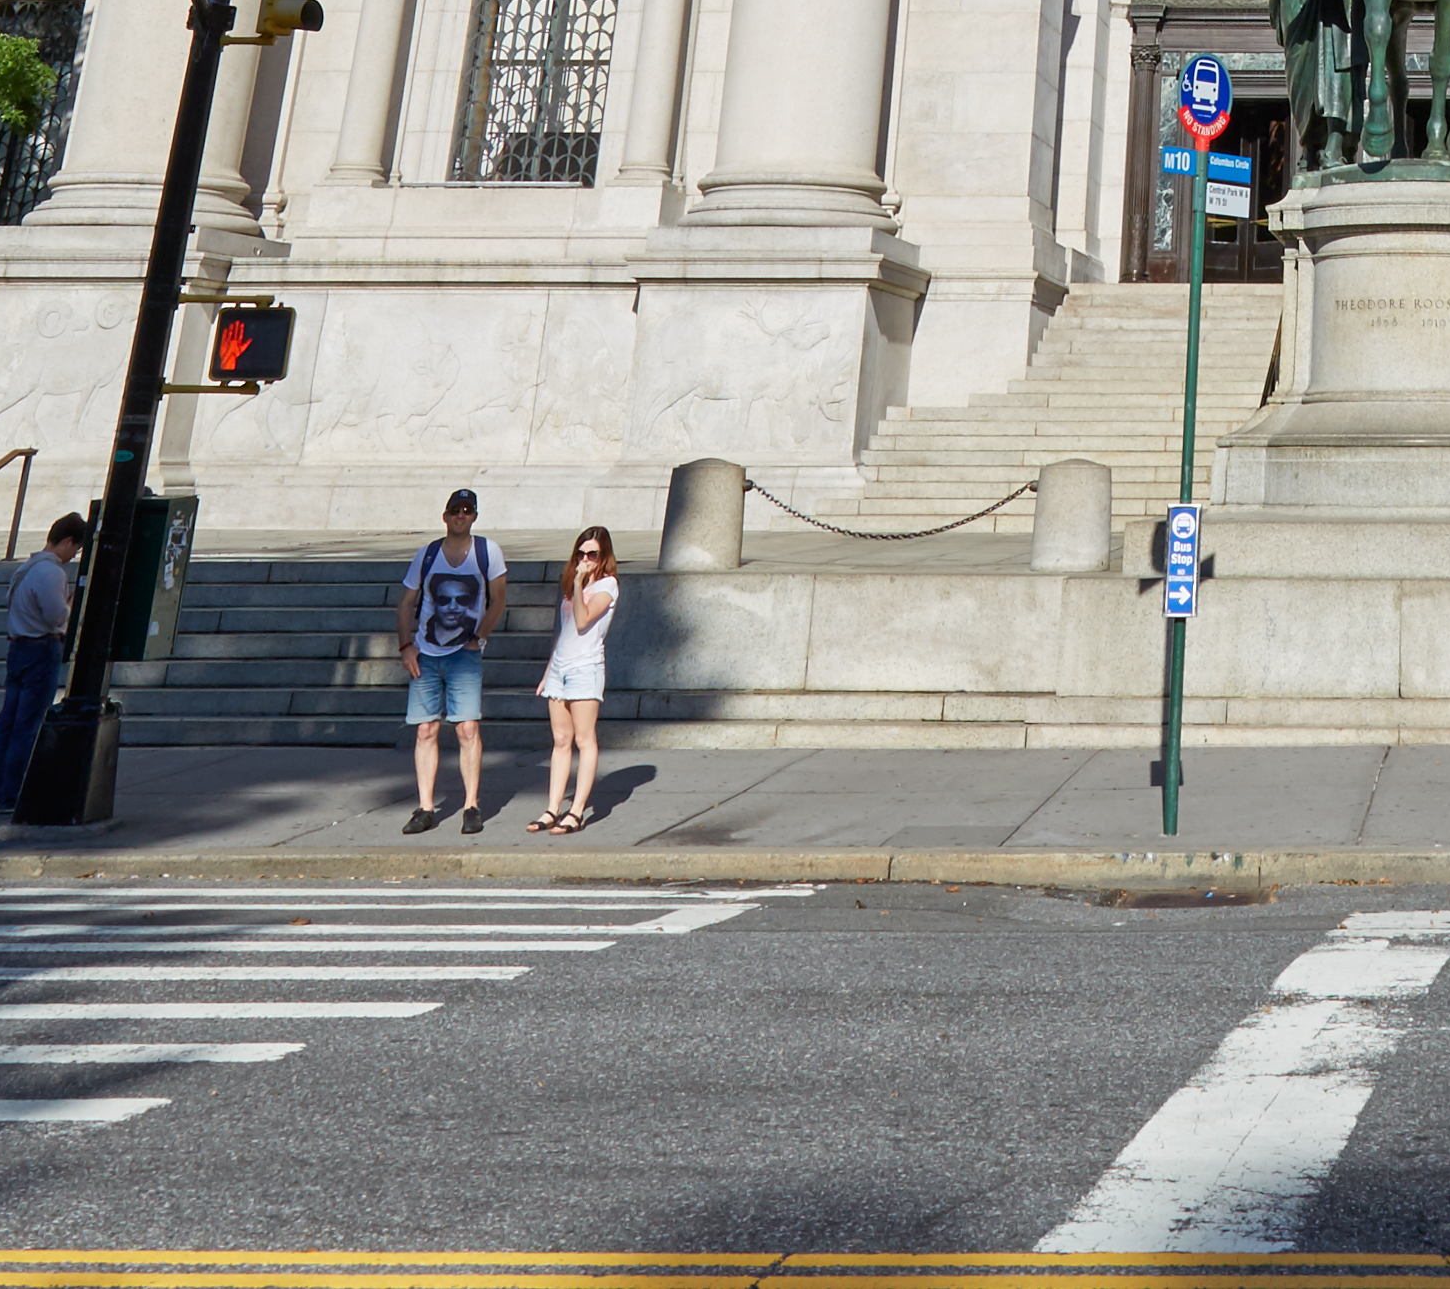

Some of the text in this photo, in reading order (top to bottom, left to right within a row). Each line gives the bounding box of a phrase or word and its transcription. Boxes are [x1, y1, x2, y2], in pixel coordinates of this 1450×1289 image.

[1183, 109, 1227, 135] NO STANDING
[1164, 151, 1191, 171] M10
[1210, 155, 1250, 170] Columbus Circle
[1209, 185, 1226, 196] Central
[1227, 187, 1238, 197] Park
[1334, 298, 1406, 311] THEODORE
[1173, 541, 1192, 553] Bus
[1171, 553, 1193, 567] Stop
